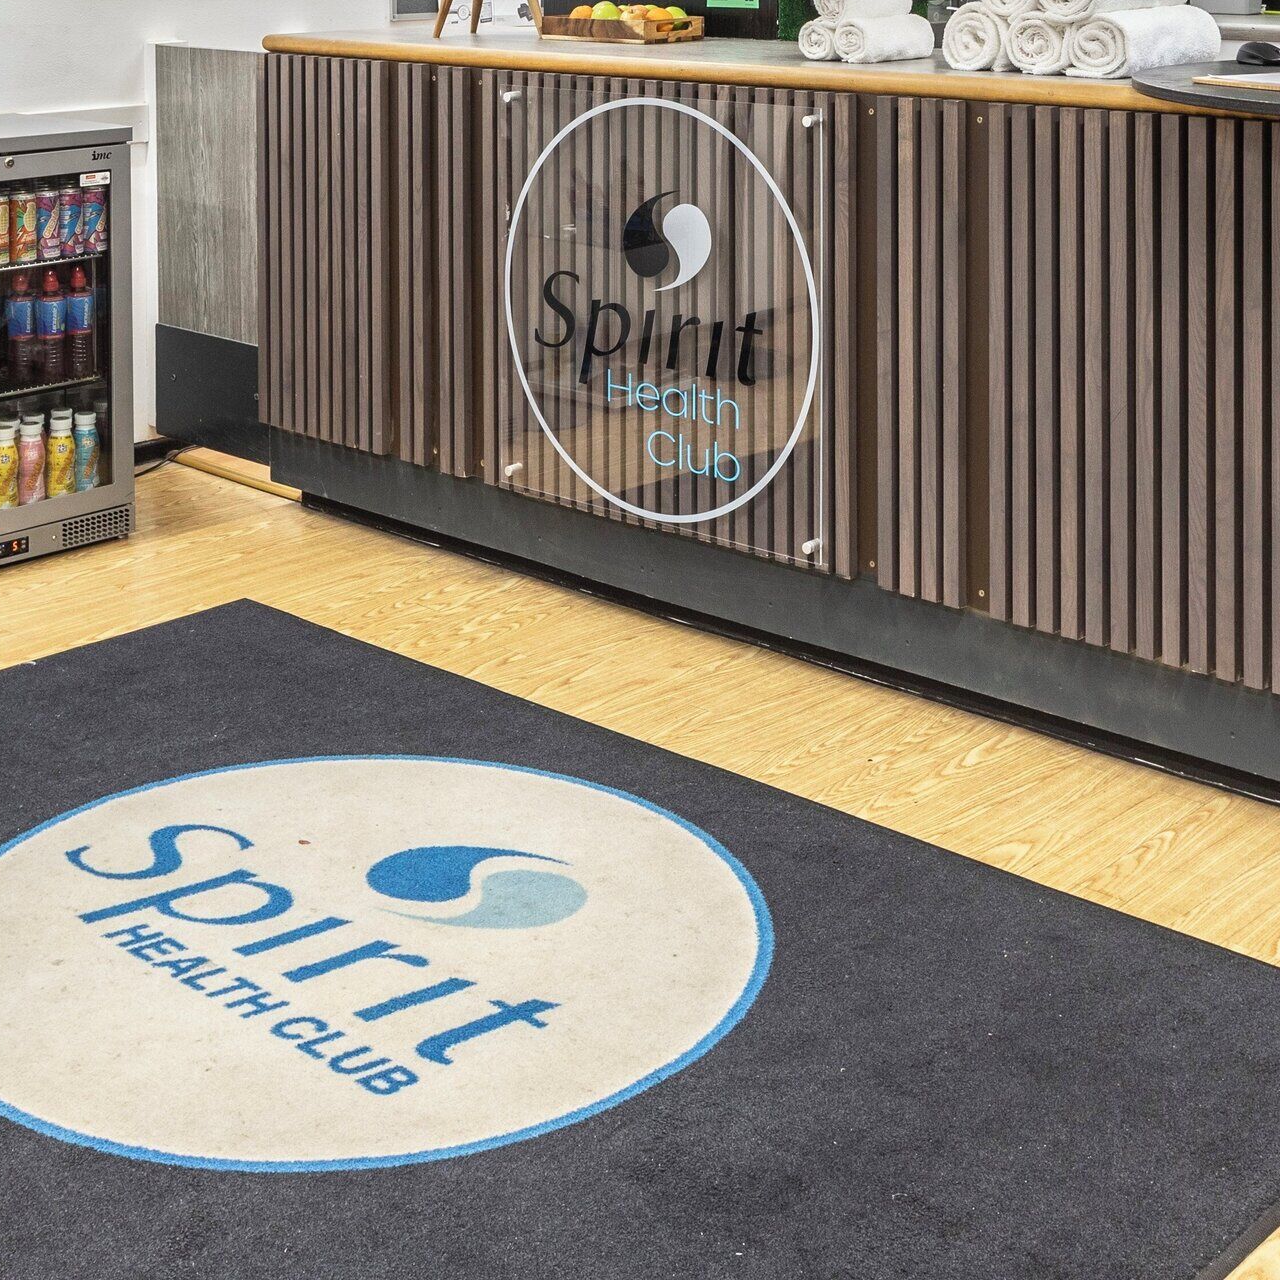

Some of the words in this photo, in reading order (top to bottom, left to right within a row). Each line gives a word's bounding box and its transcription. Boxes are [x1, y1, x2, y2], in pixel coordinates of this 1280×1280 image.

[91, 150, 113, 161] imc
[534, 270, 763, 386] Spirit
[607, 368, 740, 430] Health
[647, 430, 741, 482] Club
[12, 540, 19, 552] 5
[64, 823, 562, 1066] Spirit
[100, 923, 290, 1019] HEALTH
[269, 1016, 420, 1097] CLUB
